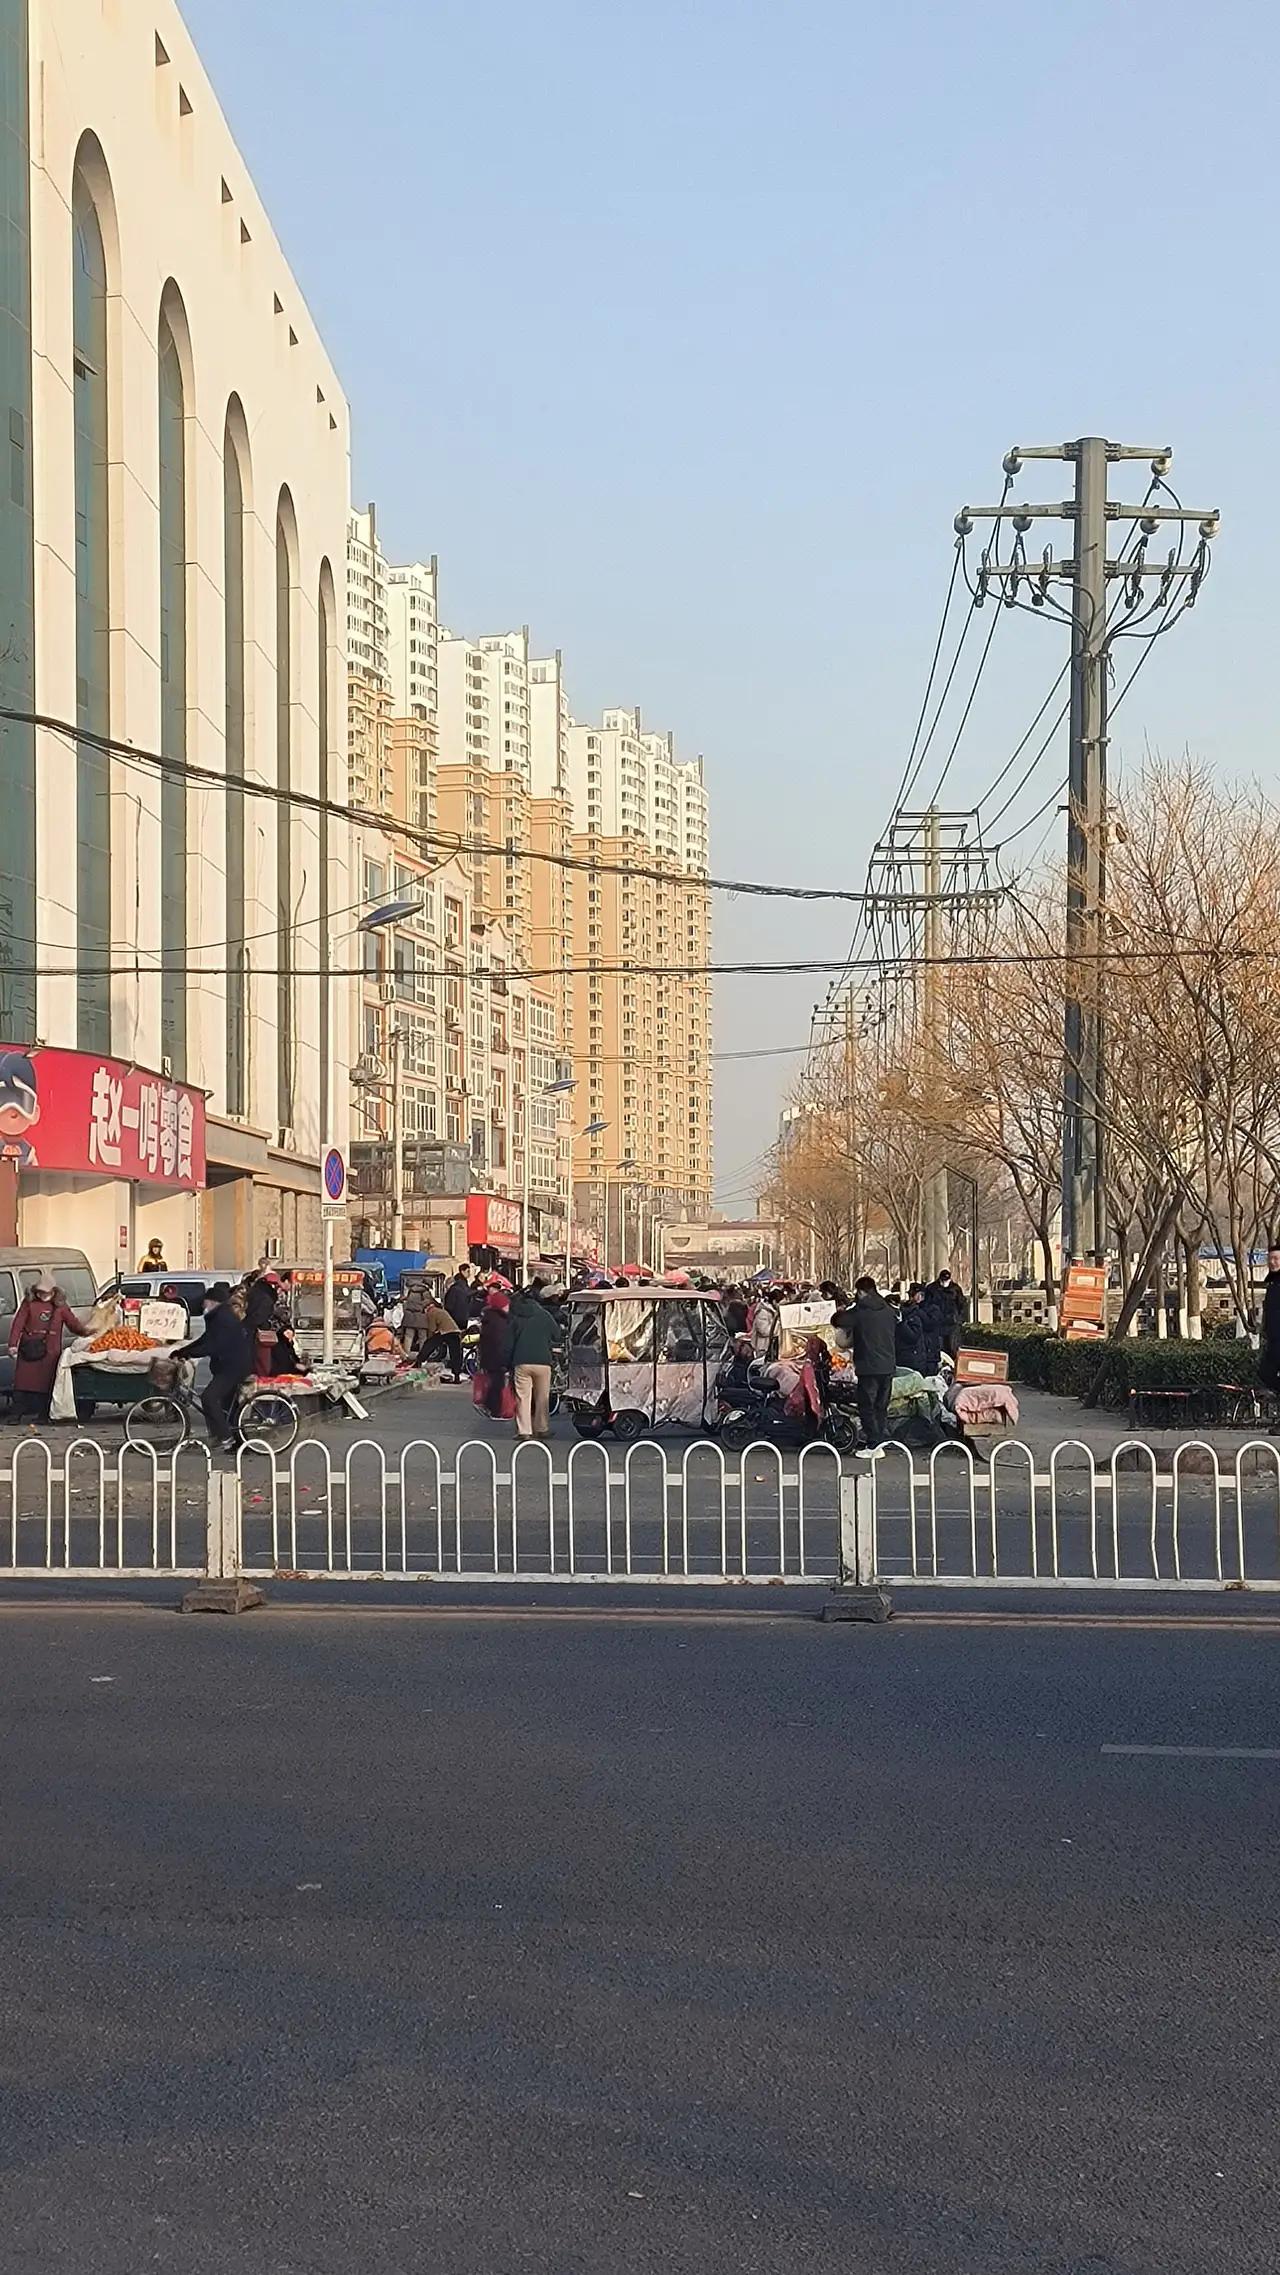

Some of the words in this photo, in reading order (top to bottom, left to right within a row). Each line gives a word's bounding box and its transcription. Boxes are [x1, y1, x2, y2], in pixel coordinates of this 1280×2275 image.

[89, 1066, 194, 1180] 赵一鸣零食
